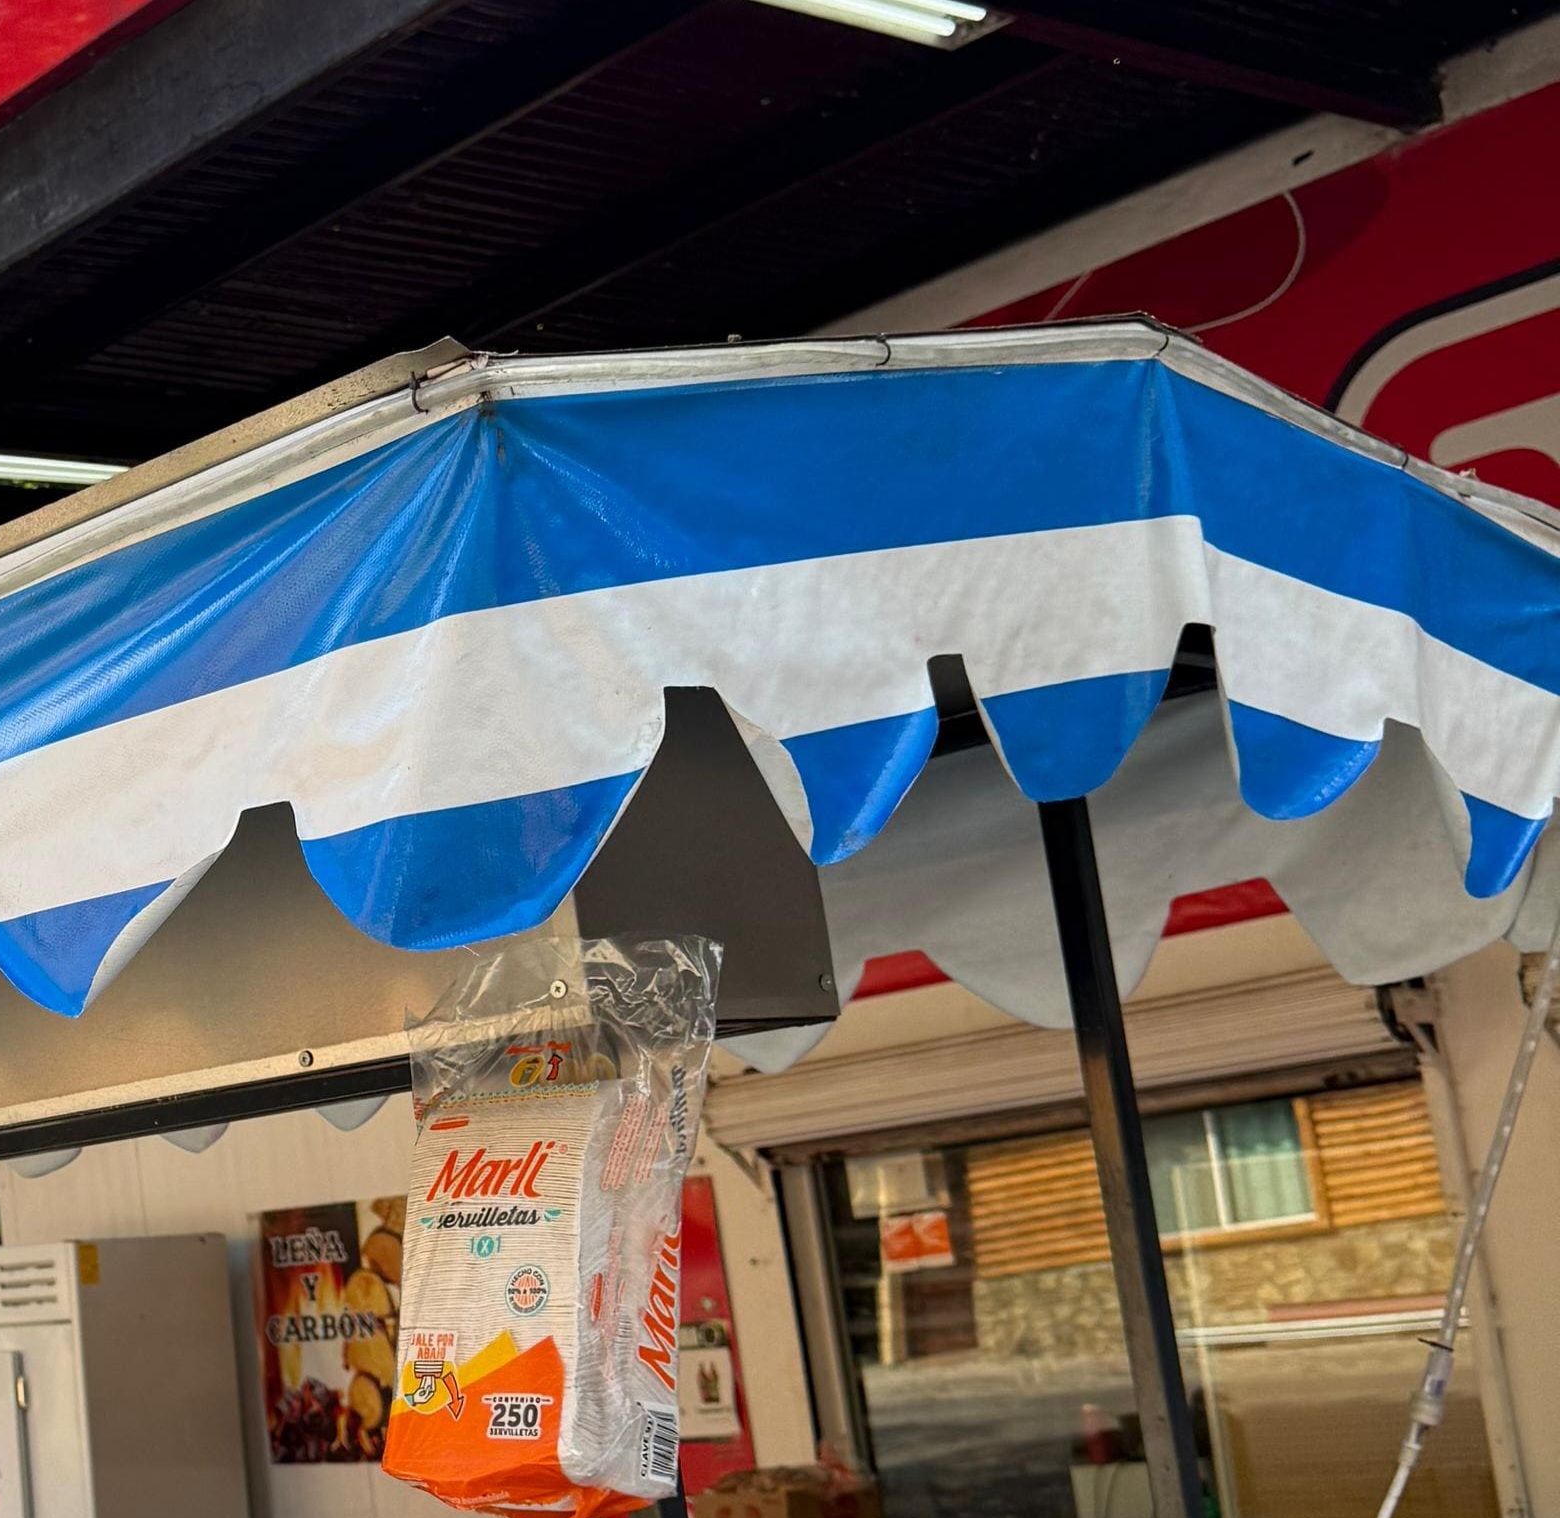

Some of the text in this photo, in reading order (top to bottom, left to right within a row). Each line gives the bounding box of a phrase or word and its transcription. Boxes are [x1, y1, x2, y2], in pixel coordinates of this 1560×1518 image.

[426, 1140, 555, 1202] Marli
[270, 1228, 348, 1267] LEÑA
[301, 1274, 320, 1302] Y
[266, 1308, 376, 1345] CARBÓN
[492, 1404, 538, 1428] 250
